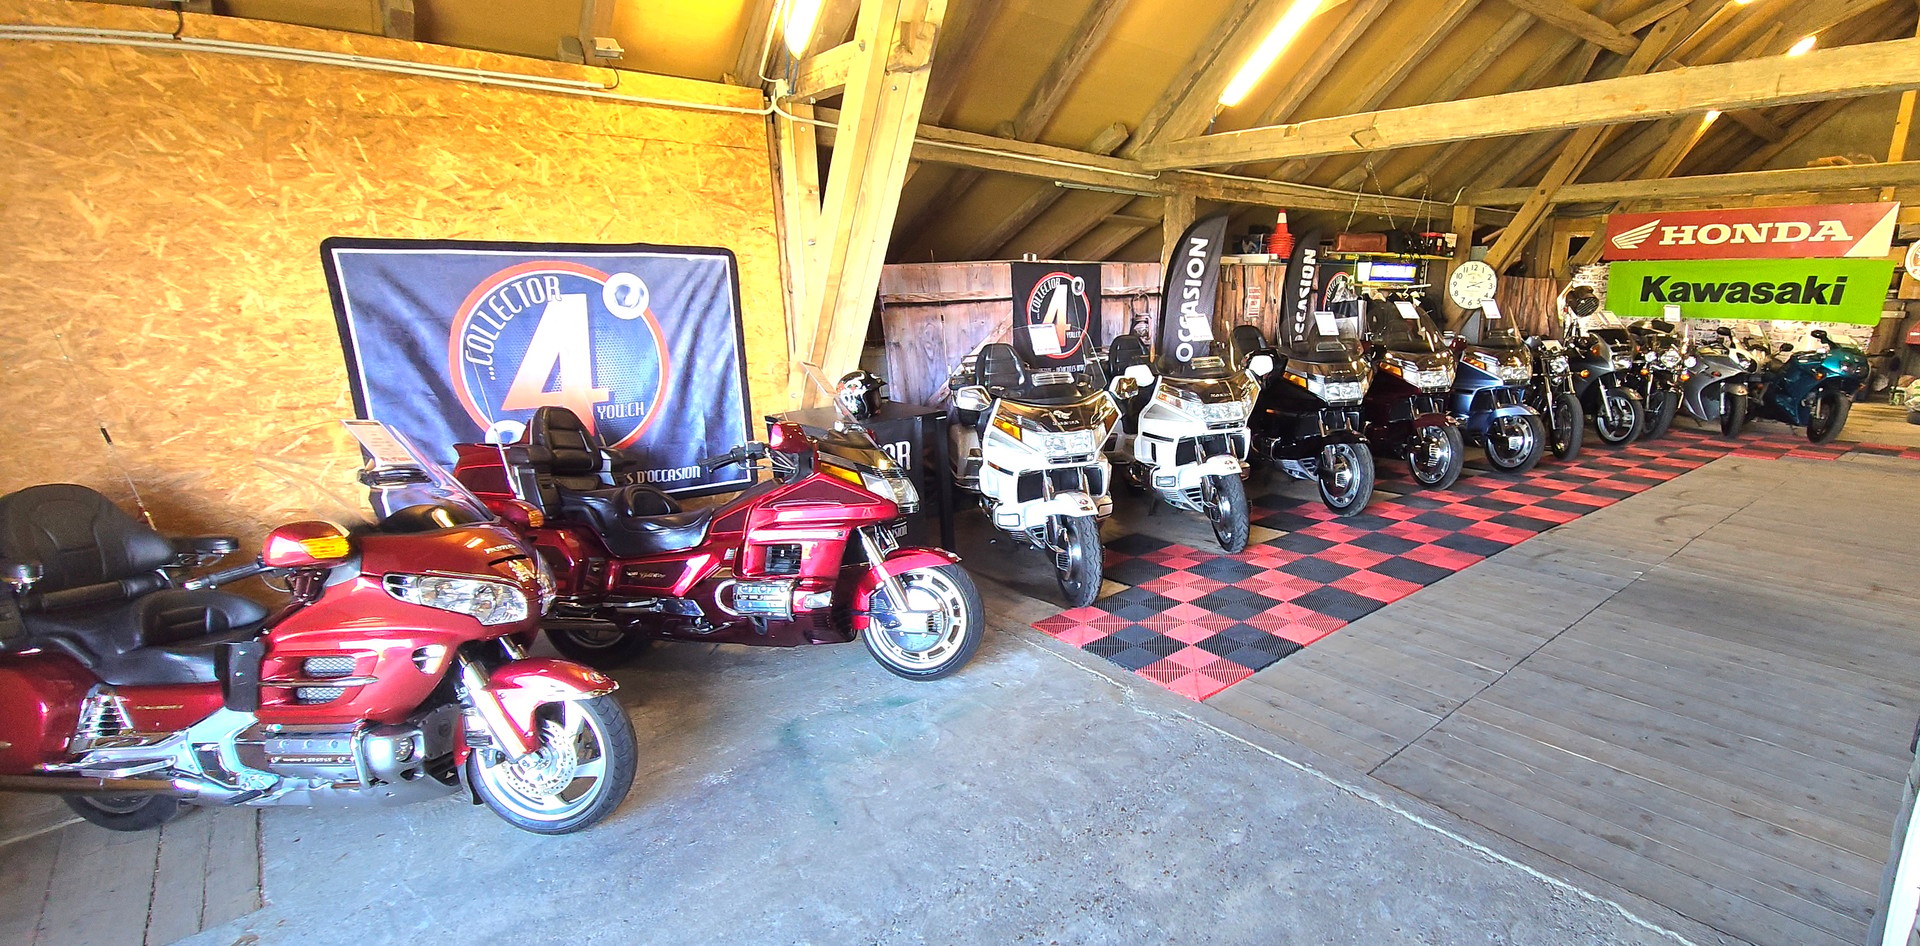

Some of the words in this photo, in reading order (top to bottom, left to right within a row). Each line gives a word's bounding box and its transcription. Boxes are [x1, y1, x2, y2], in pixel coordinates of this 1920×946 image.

[1658, 219, 1854, 245] HONDA
[1456, 272, 1463, 280] 10
[1639, 275, 1848, 306] Kawasaki
[501, 293, 610, 437] 4
[596, 401, 645, 420] YOU.CH
[636, 465, 701, 484] D'OCCASION
